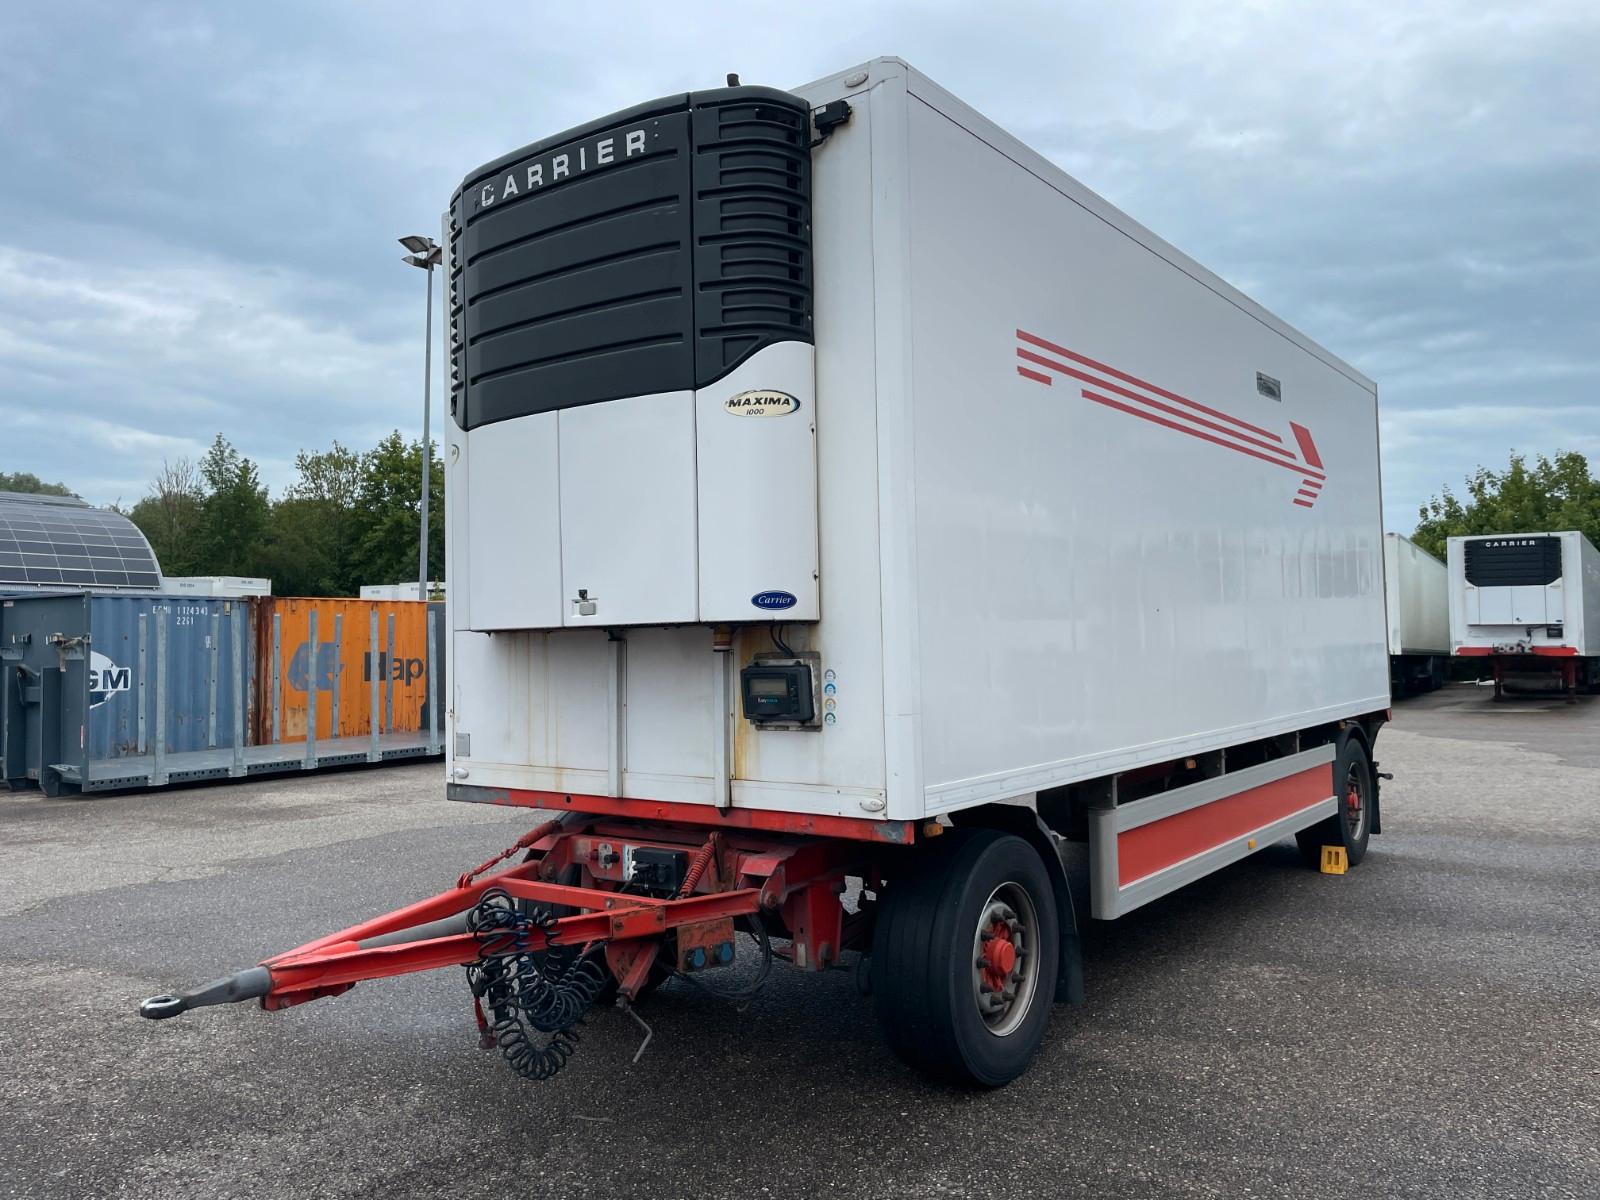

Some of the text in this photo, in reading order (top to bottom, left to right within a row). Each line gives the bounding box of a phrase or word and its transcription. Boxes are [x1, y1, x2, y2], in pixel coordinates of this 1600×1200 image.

[481, 129, 646, 207] CARRIER
[728, 397, 791, 407] MAXIMA
[1485, 540, 1536, 548] CARRIER
[758, 595, 792, 605] Carrier
